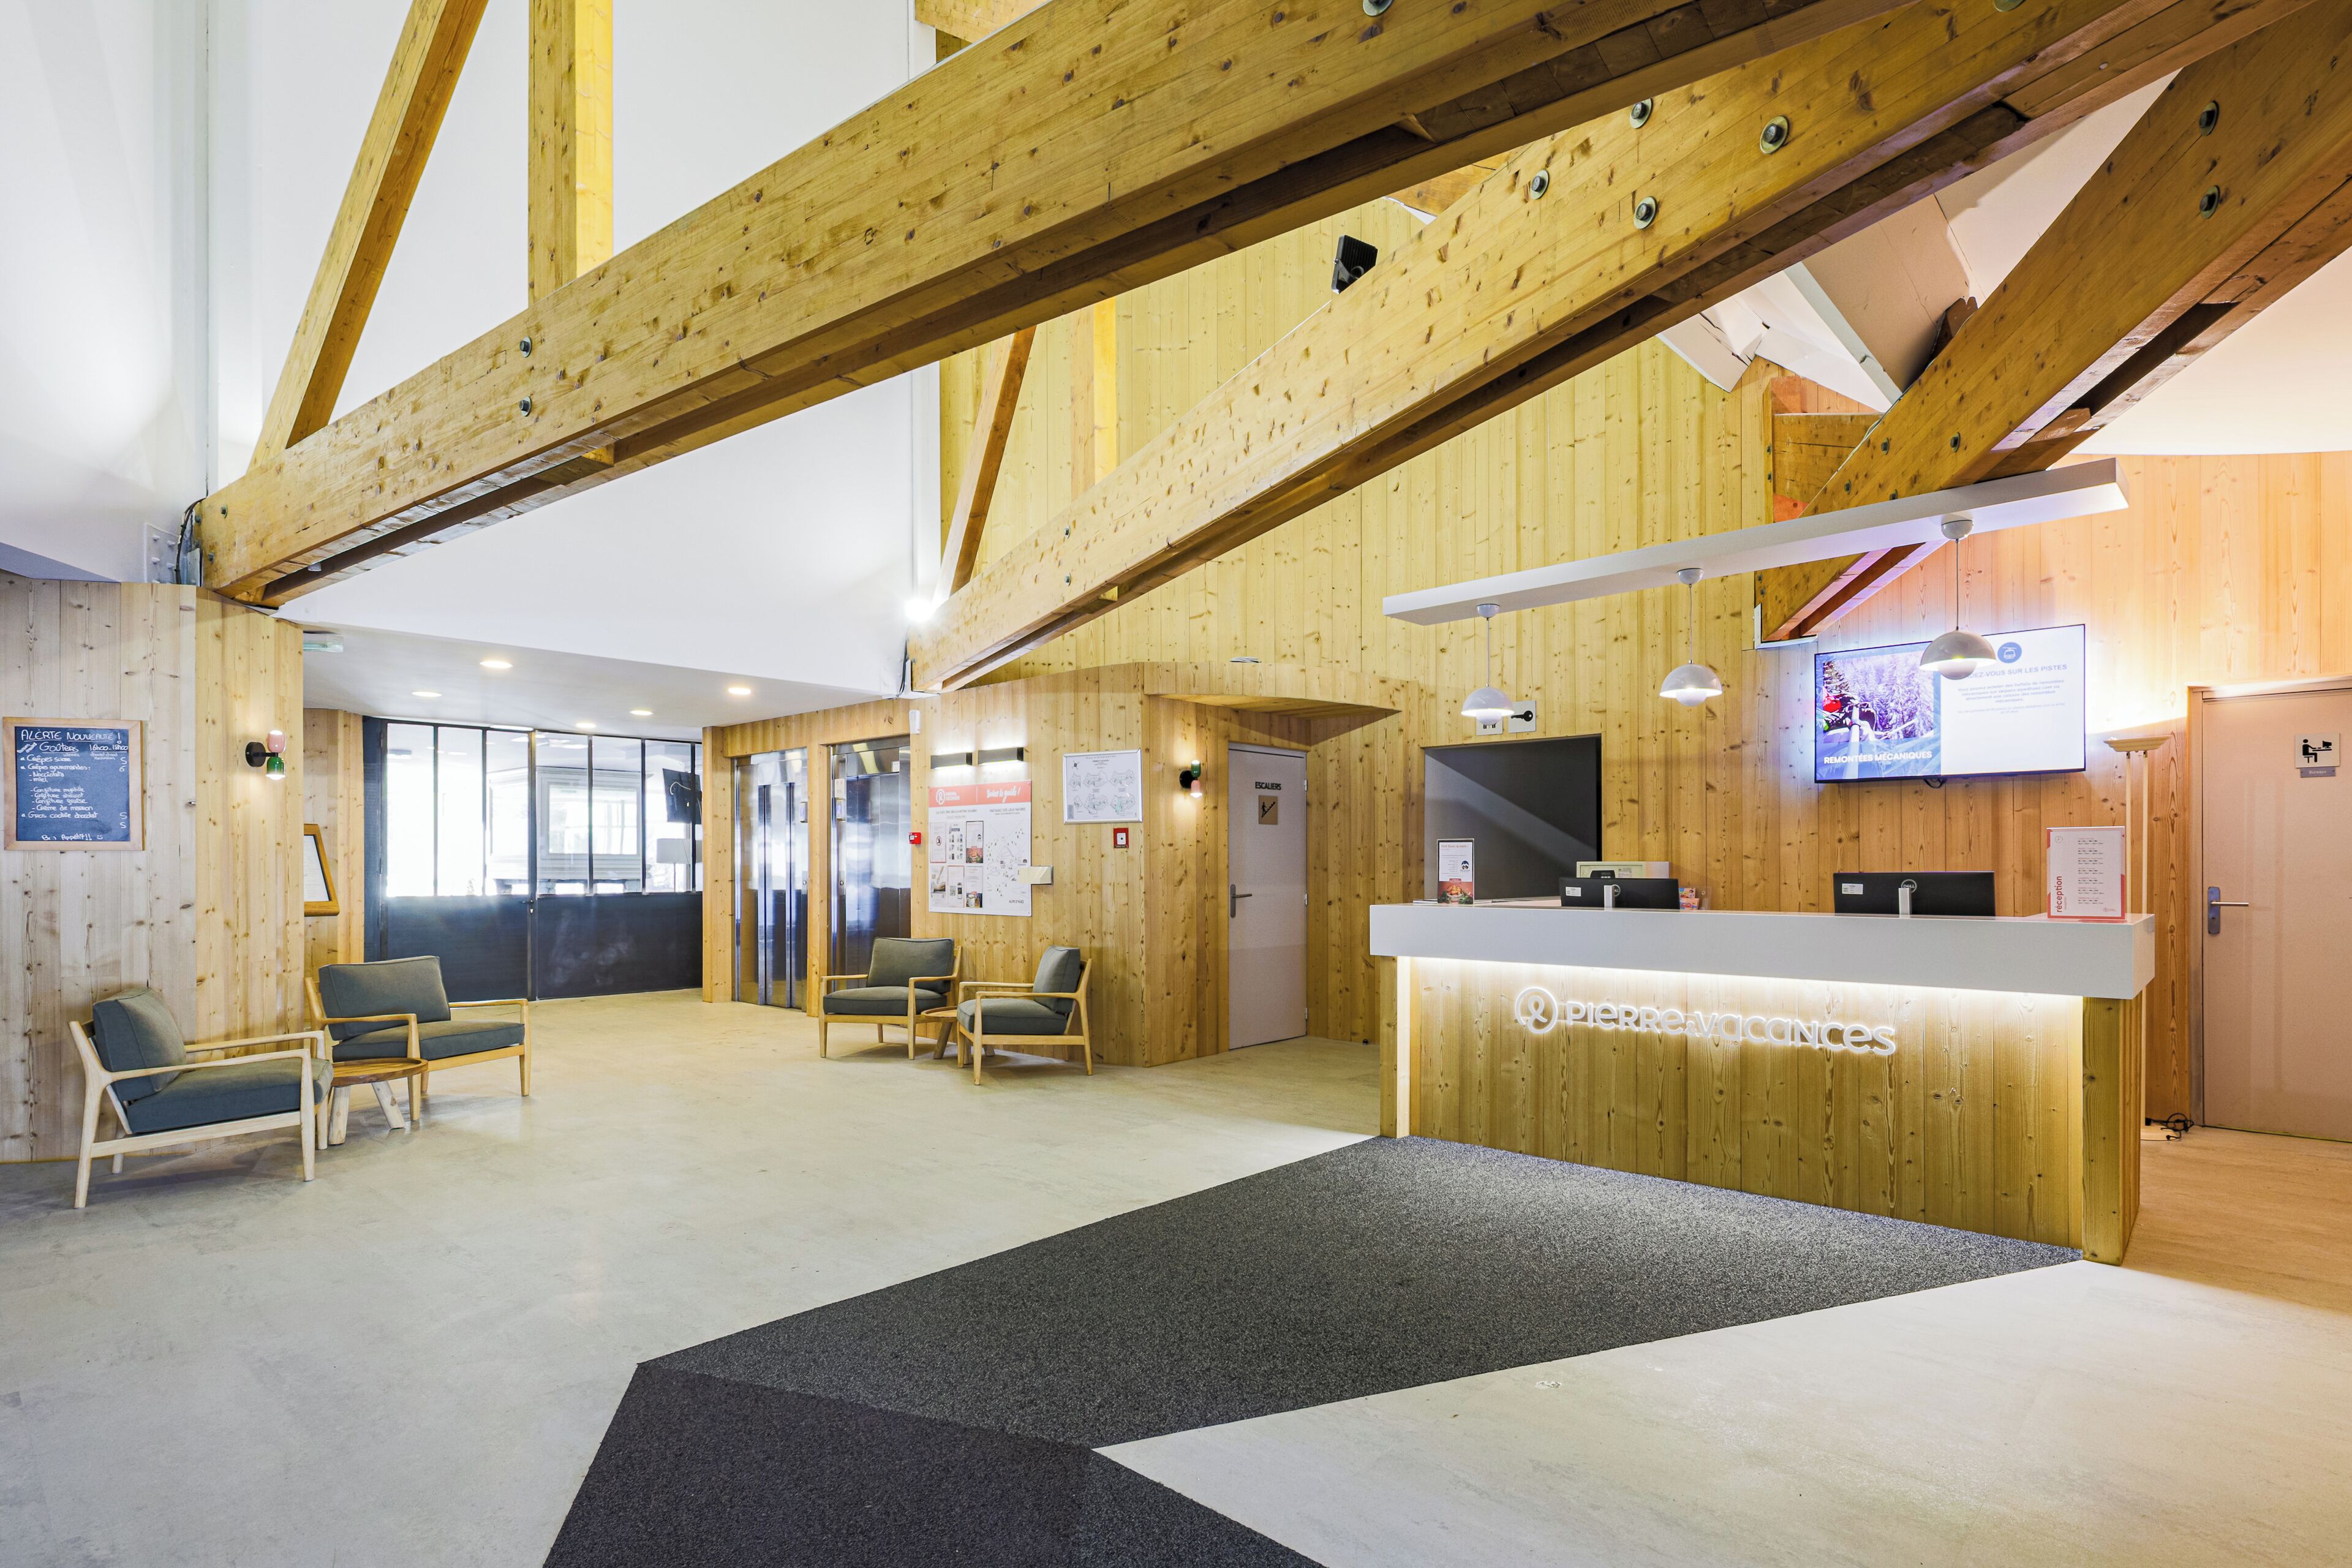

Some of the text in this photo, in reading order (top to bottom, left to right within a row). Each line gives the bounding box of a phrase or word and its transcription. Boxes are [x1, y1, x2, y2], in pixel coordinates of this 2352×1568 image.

[1823, 751, 1932, 764] REMONTÉES MÉCANIQUES
[1255, 782, 1282, 791] ESCALIERS
[2054, 876, 2064, 913] réception
